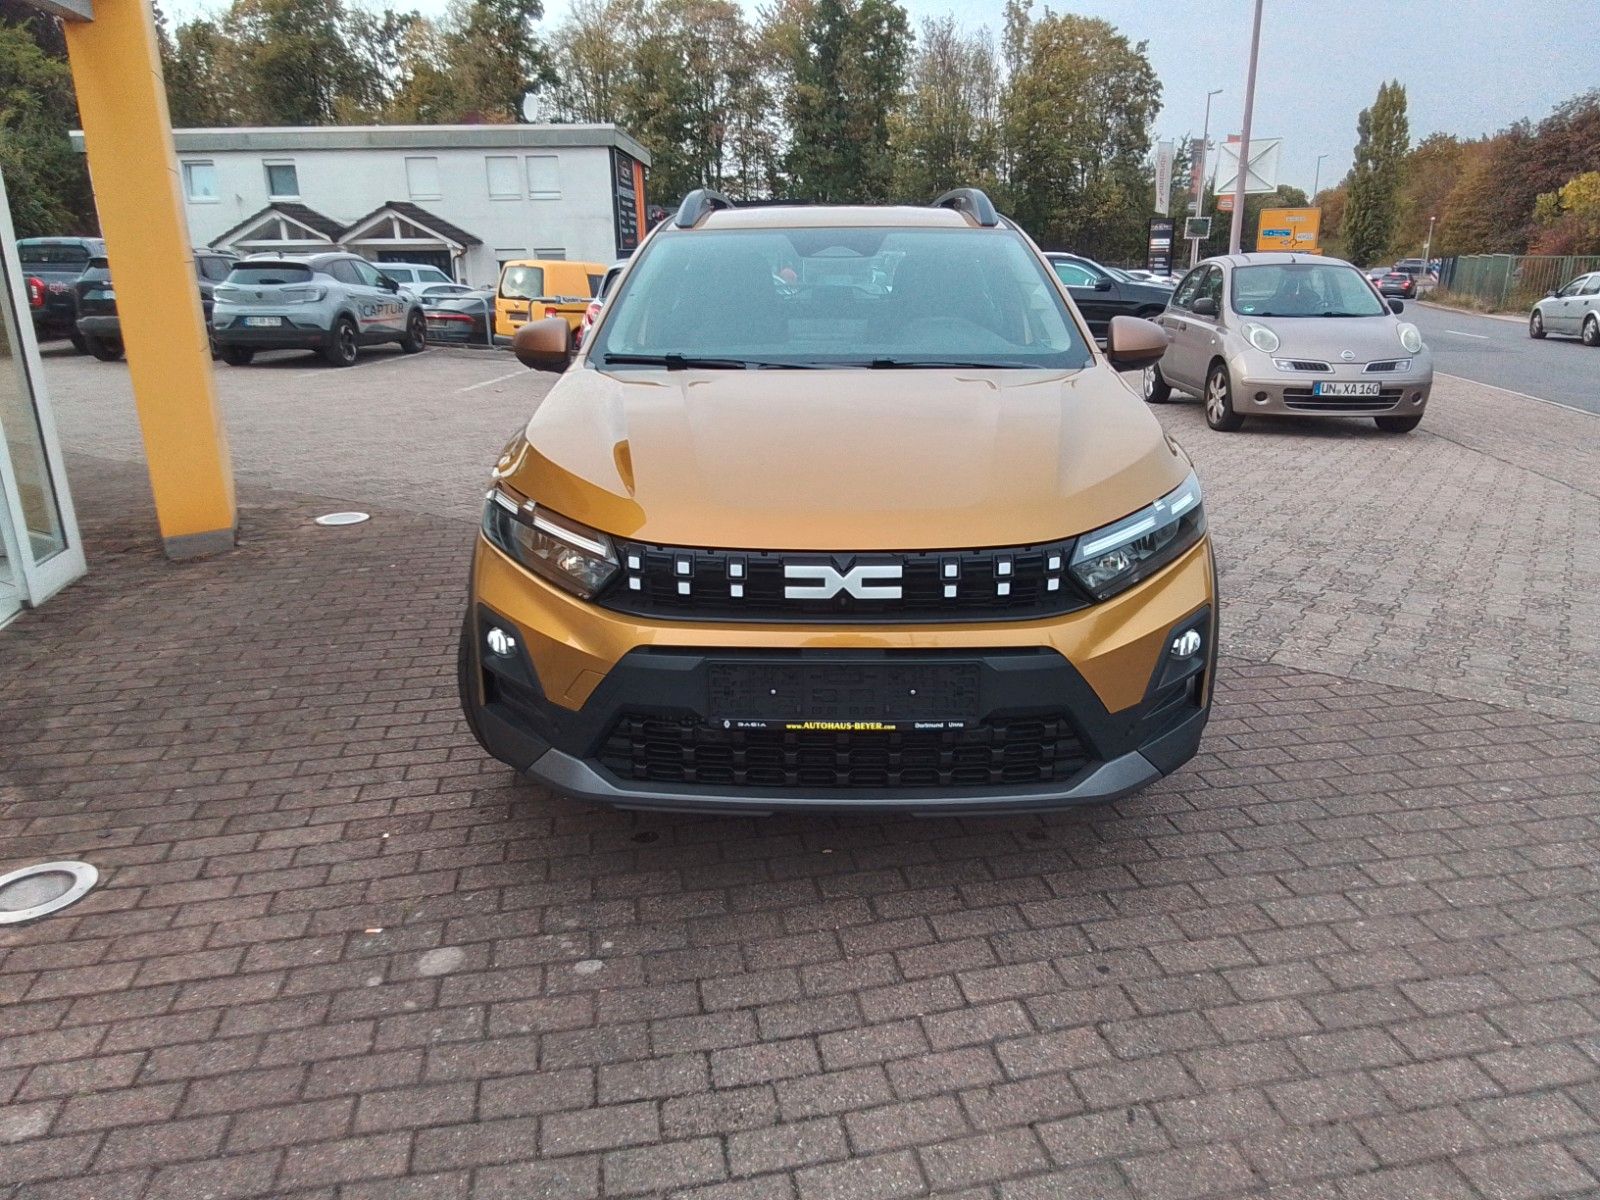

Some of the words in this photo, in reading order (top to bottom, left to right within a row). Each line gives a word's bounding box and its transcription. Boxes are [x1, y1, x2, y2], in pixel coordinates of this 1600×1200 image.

[363, 302, 404, 317] CAPTUR
[1321, 383, 1336, 394] UN
[1343, 383, 1357, 395] XA
[1359, 384, 1379, 395] 160
[914, 721, 944, 729] Dortmund
